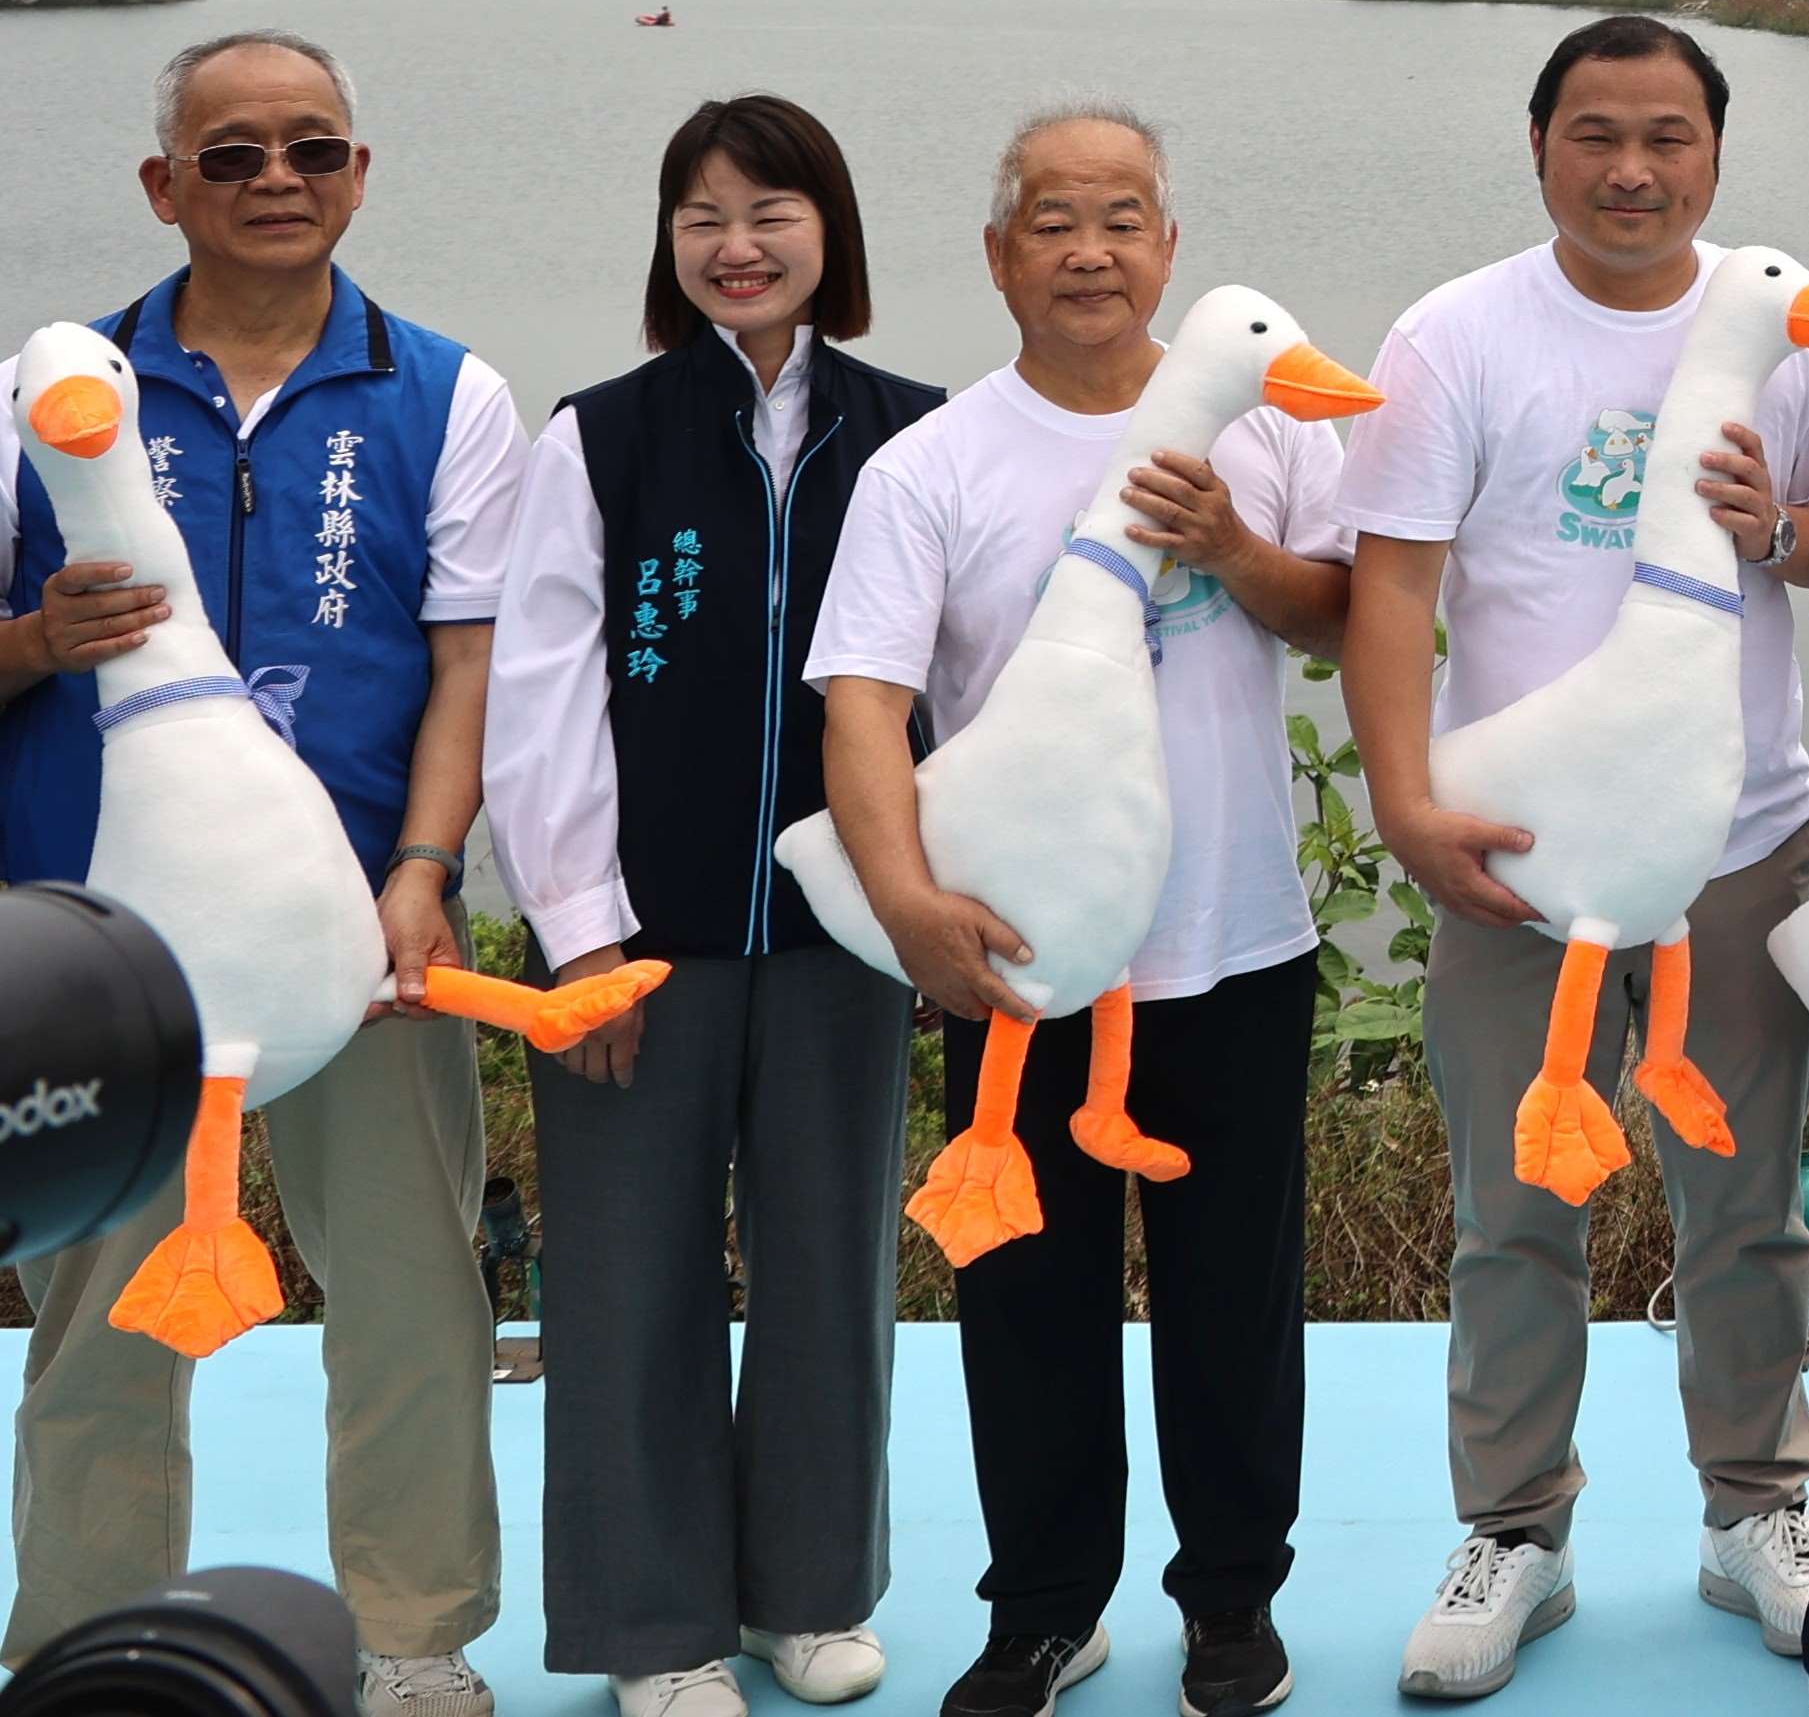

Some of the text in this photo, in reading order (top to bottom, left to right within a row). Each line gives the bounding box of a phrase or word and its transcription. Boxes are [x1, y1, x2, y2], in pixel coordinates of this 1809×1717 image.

[311, 429, 365, 630] 雲林縣政府
[671, 528, 704, 621] 總幹事
[626, 557, 669, 684] 呂惠玲
